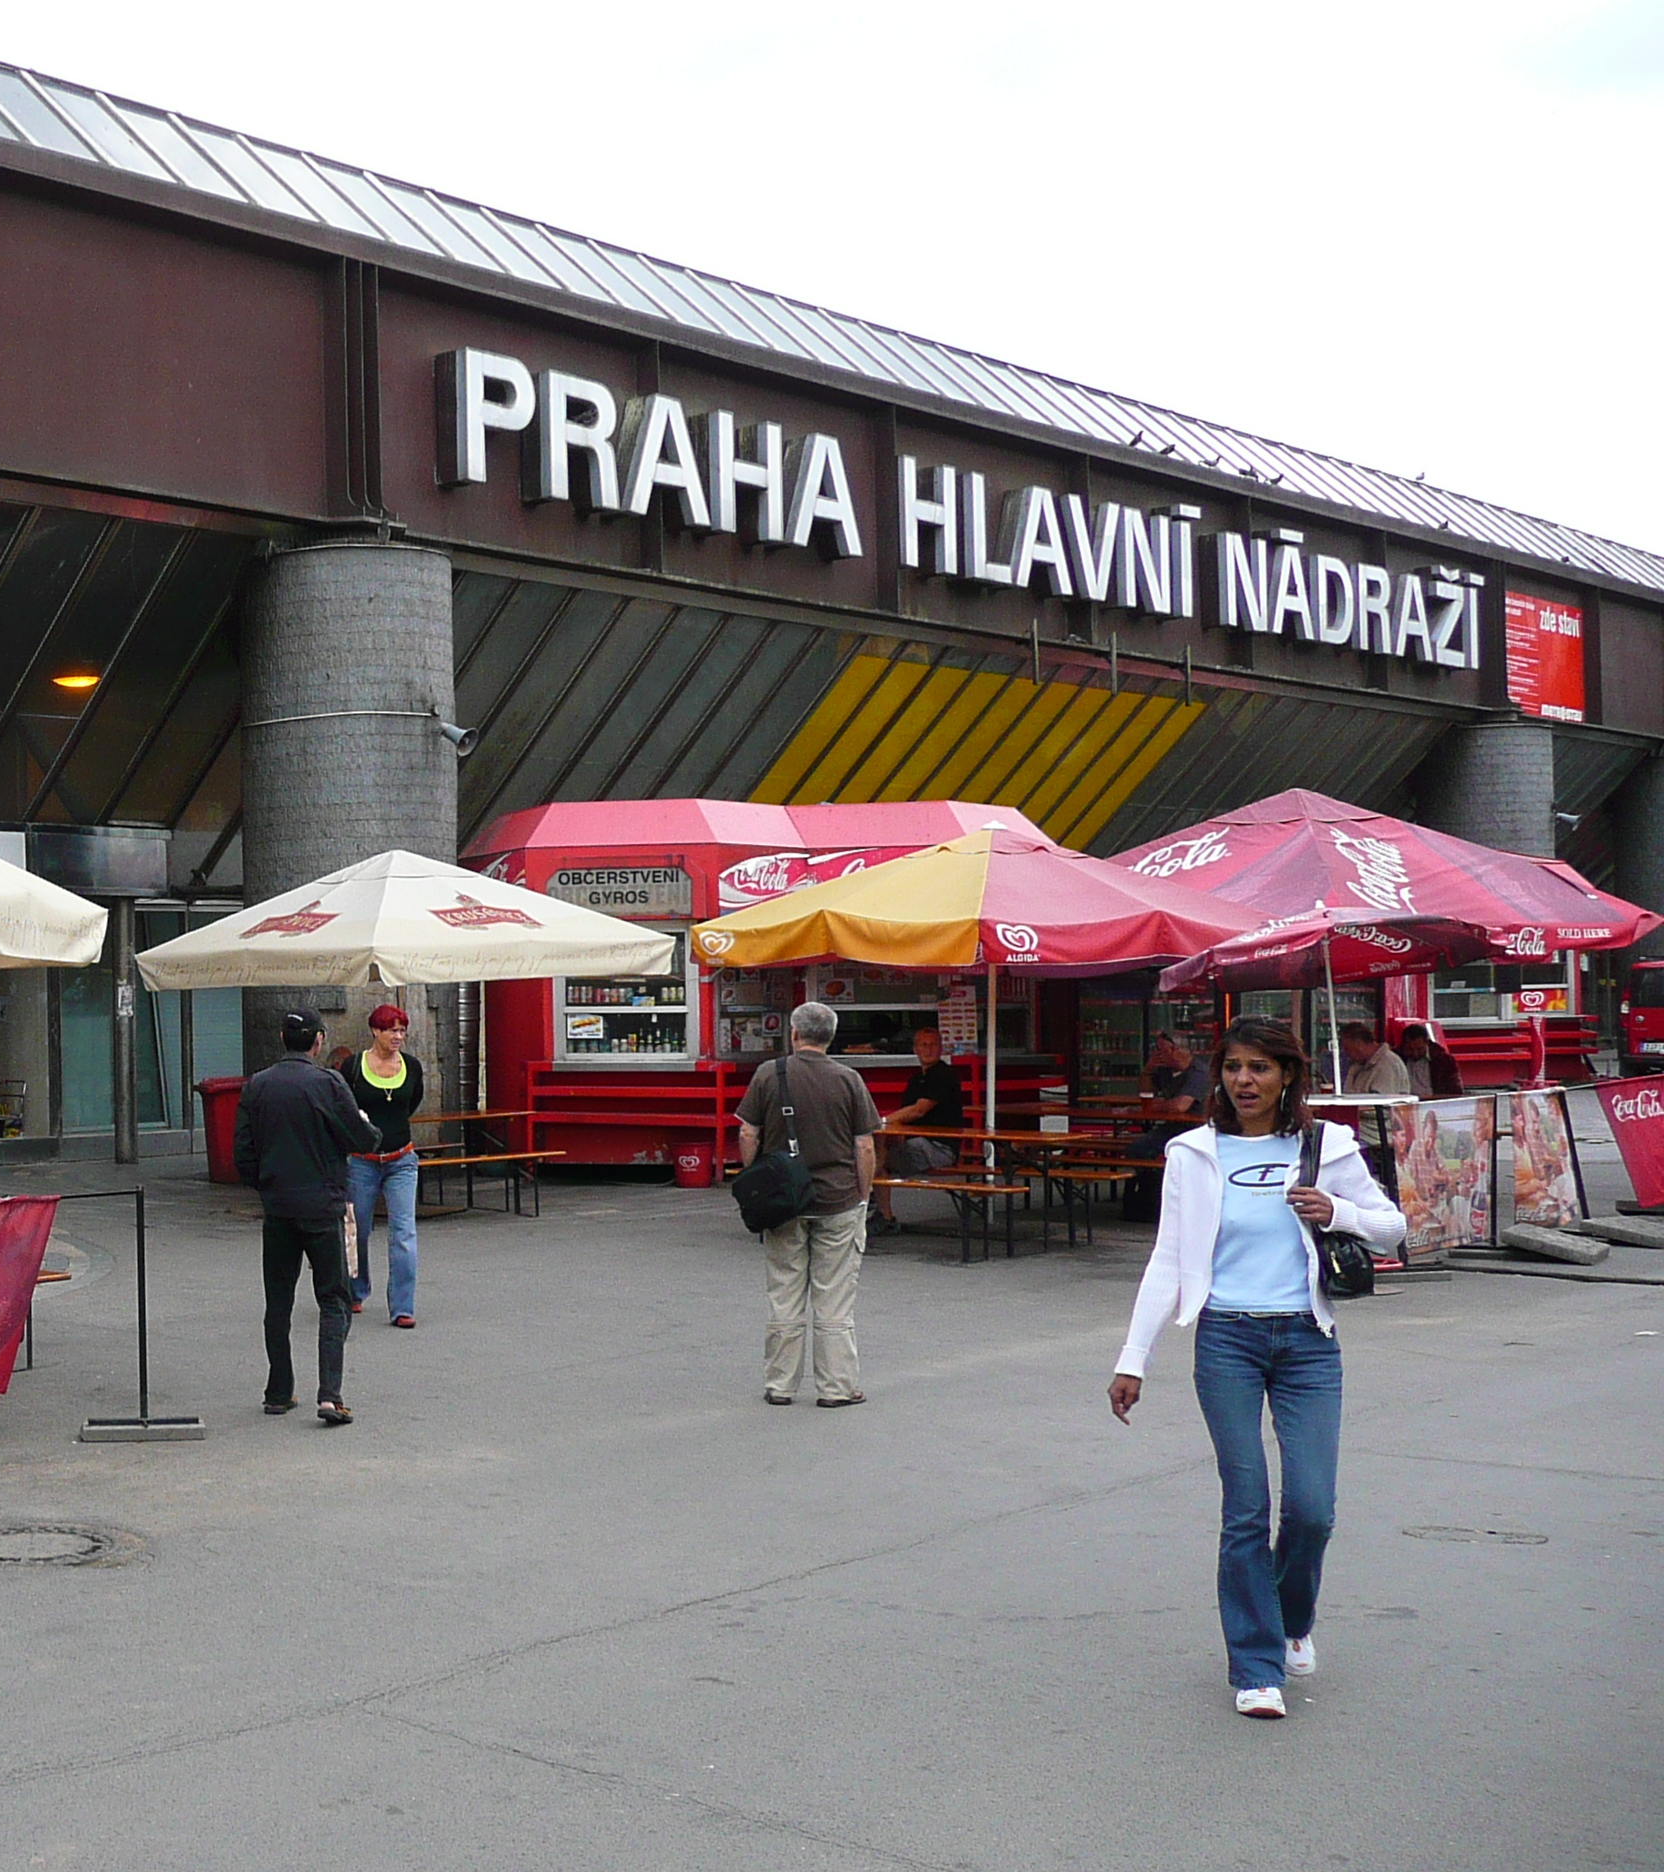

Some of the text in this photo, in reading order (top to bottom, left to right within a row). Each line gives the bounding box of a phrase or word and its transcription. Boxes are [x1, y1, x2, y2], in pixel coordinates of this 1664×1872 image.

[452, 346, 863, 559] PRAHA
[1329, 826, 1418, 915] Coca-Cola
[588, 890, 650, 905] GYROS
[1557, 928, 1582, 939] SOLD
[1583, 928, 1613, 939] HERE
[1005, 953, 1040, 963] ALGIDA
